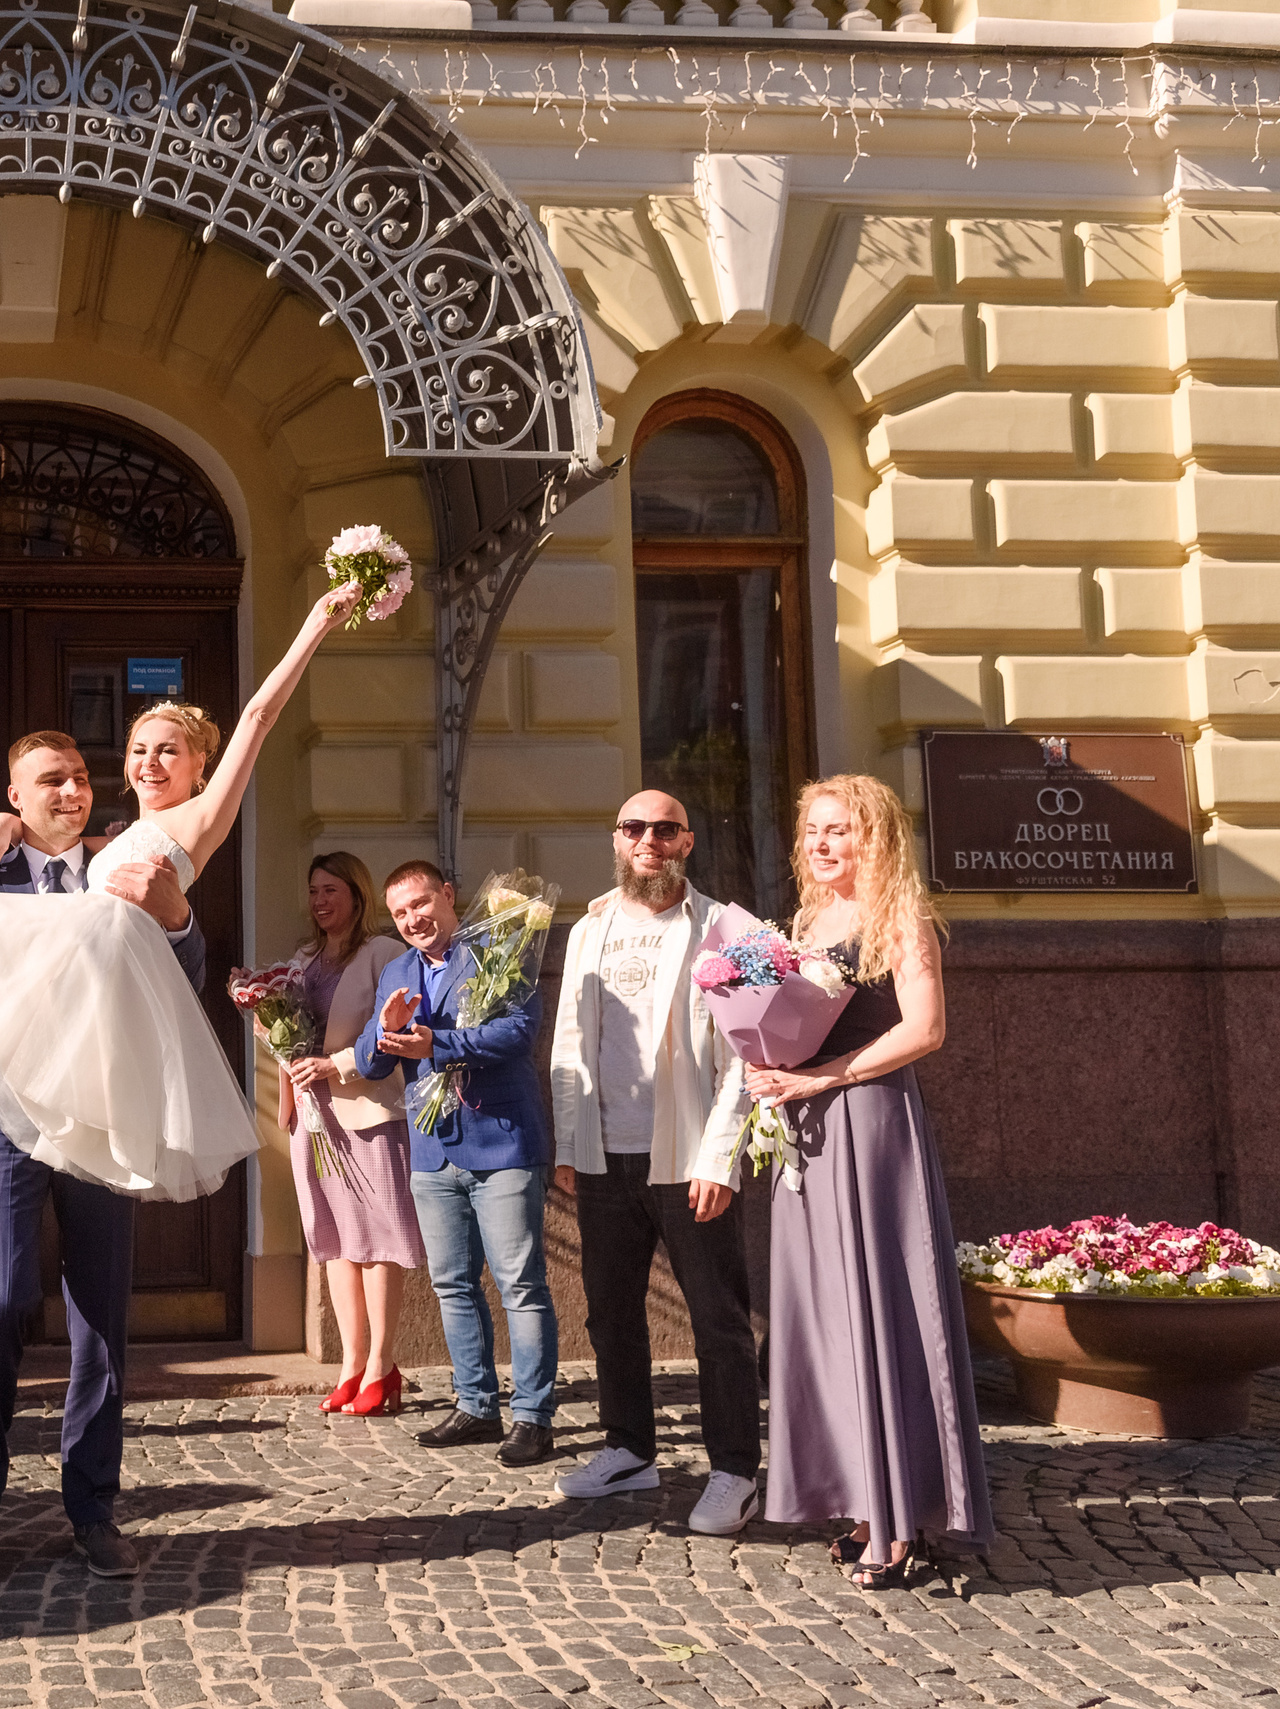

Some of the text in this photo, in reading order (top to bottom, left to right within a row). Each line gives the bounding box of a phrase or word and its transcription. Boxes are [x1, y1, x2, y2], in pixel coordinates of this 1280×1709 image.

[1015, 823, 1112, 844] ДВОРЕЦ
[954, 851, 1175, 870] БРАКОСОЧЕТАНИЯ
[1102, 875, 1116, 885] 52
[604, 935, 663, 956] OM TAIL
